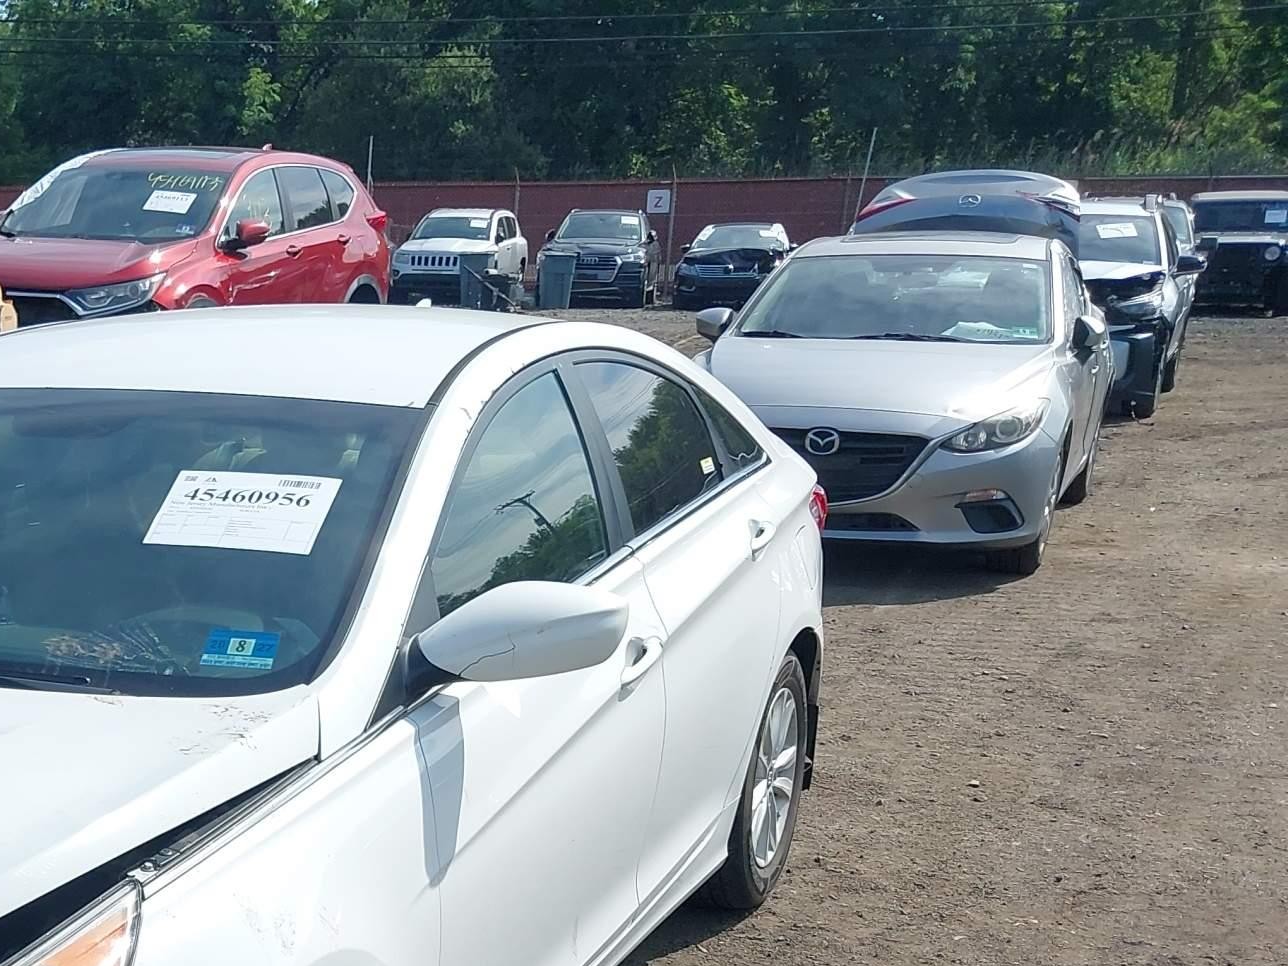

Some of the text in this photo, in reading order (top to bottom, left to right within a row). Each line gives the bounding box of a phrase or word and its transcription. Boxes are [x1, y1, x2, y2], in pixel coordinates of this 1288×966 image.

[654, 196, 663, 208] Z
[184, 487, 314, 508] 45460956
[236, 640, 247, 653] 8
